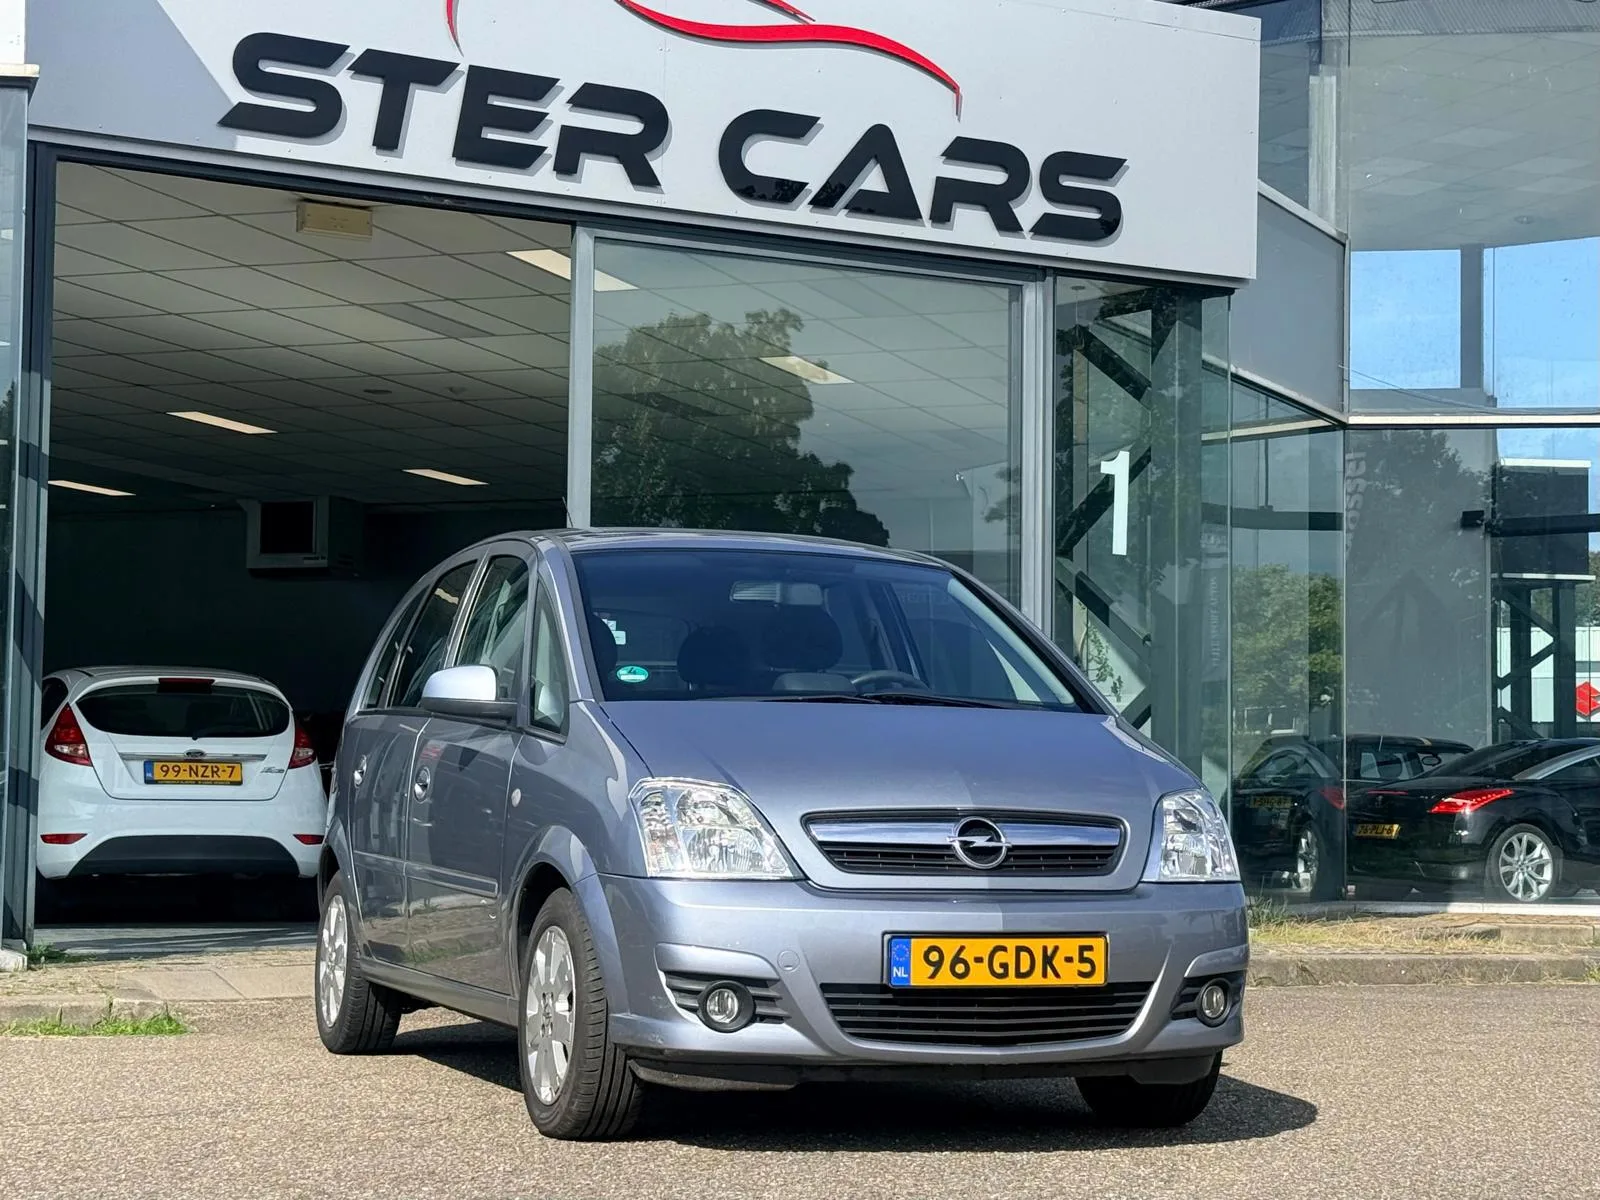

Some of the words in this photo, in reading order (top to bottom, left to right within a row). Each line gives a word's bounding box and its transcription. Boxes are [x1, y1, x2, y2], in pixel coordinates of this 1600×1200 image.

[216, 32, 669, 187] STER
[718, 109, 1127, 241] CARS
[1100, 450, 1130, 555] 1
[160, 764, 236, 779] 99-NZR-7
[893, 967, 908, 977] NL
[923, 945, 1097, 979] 96-GDK-5
